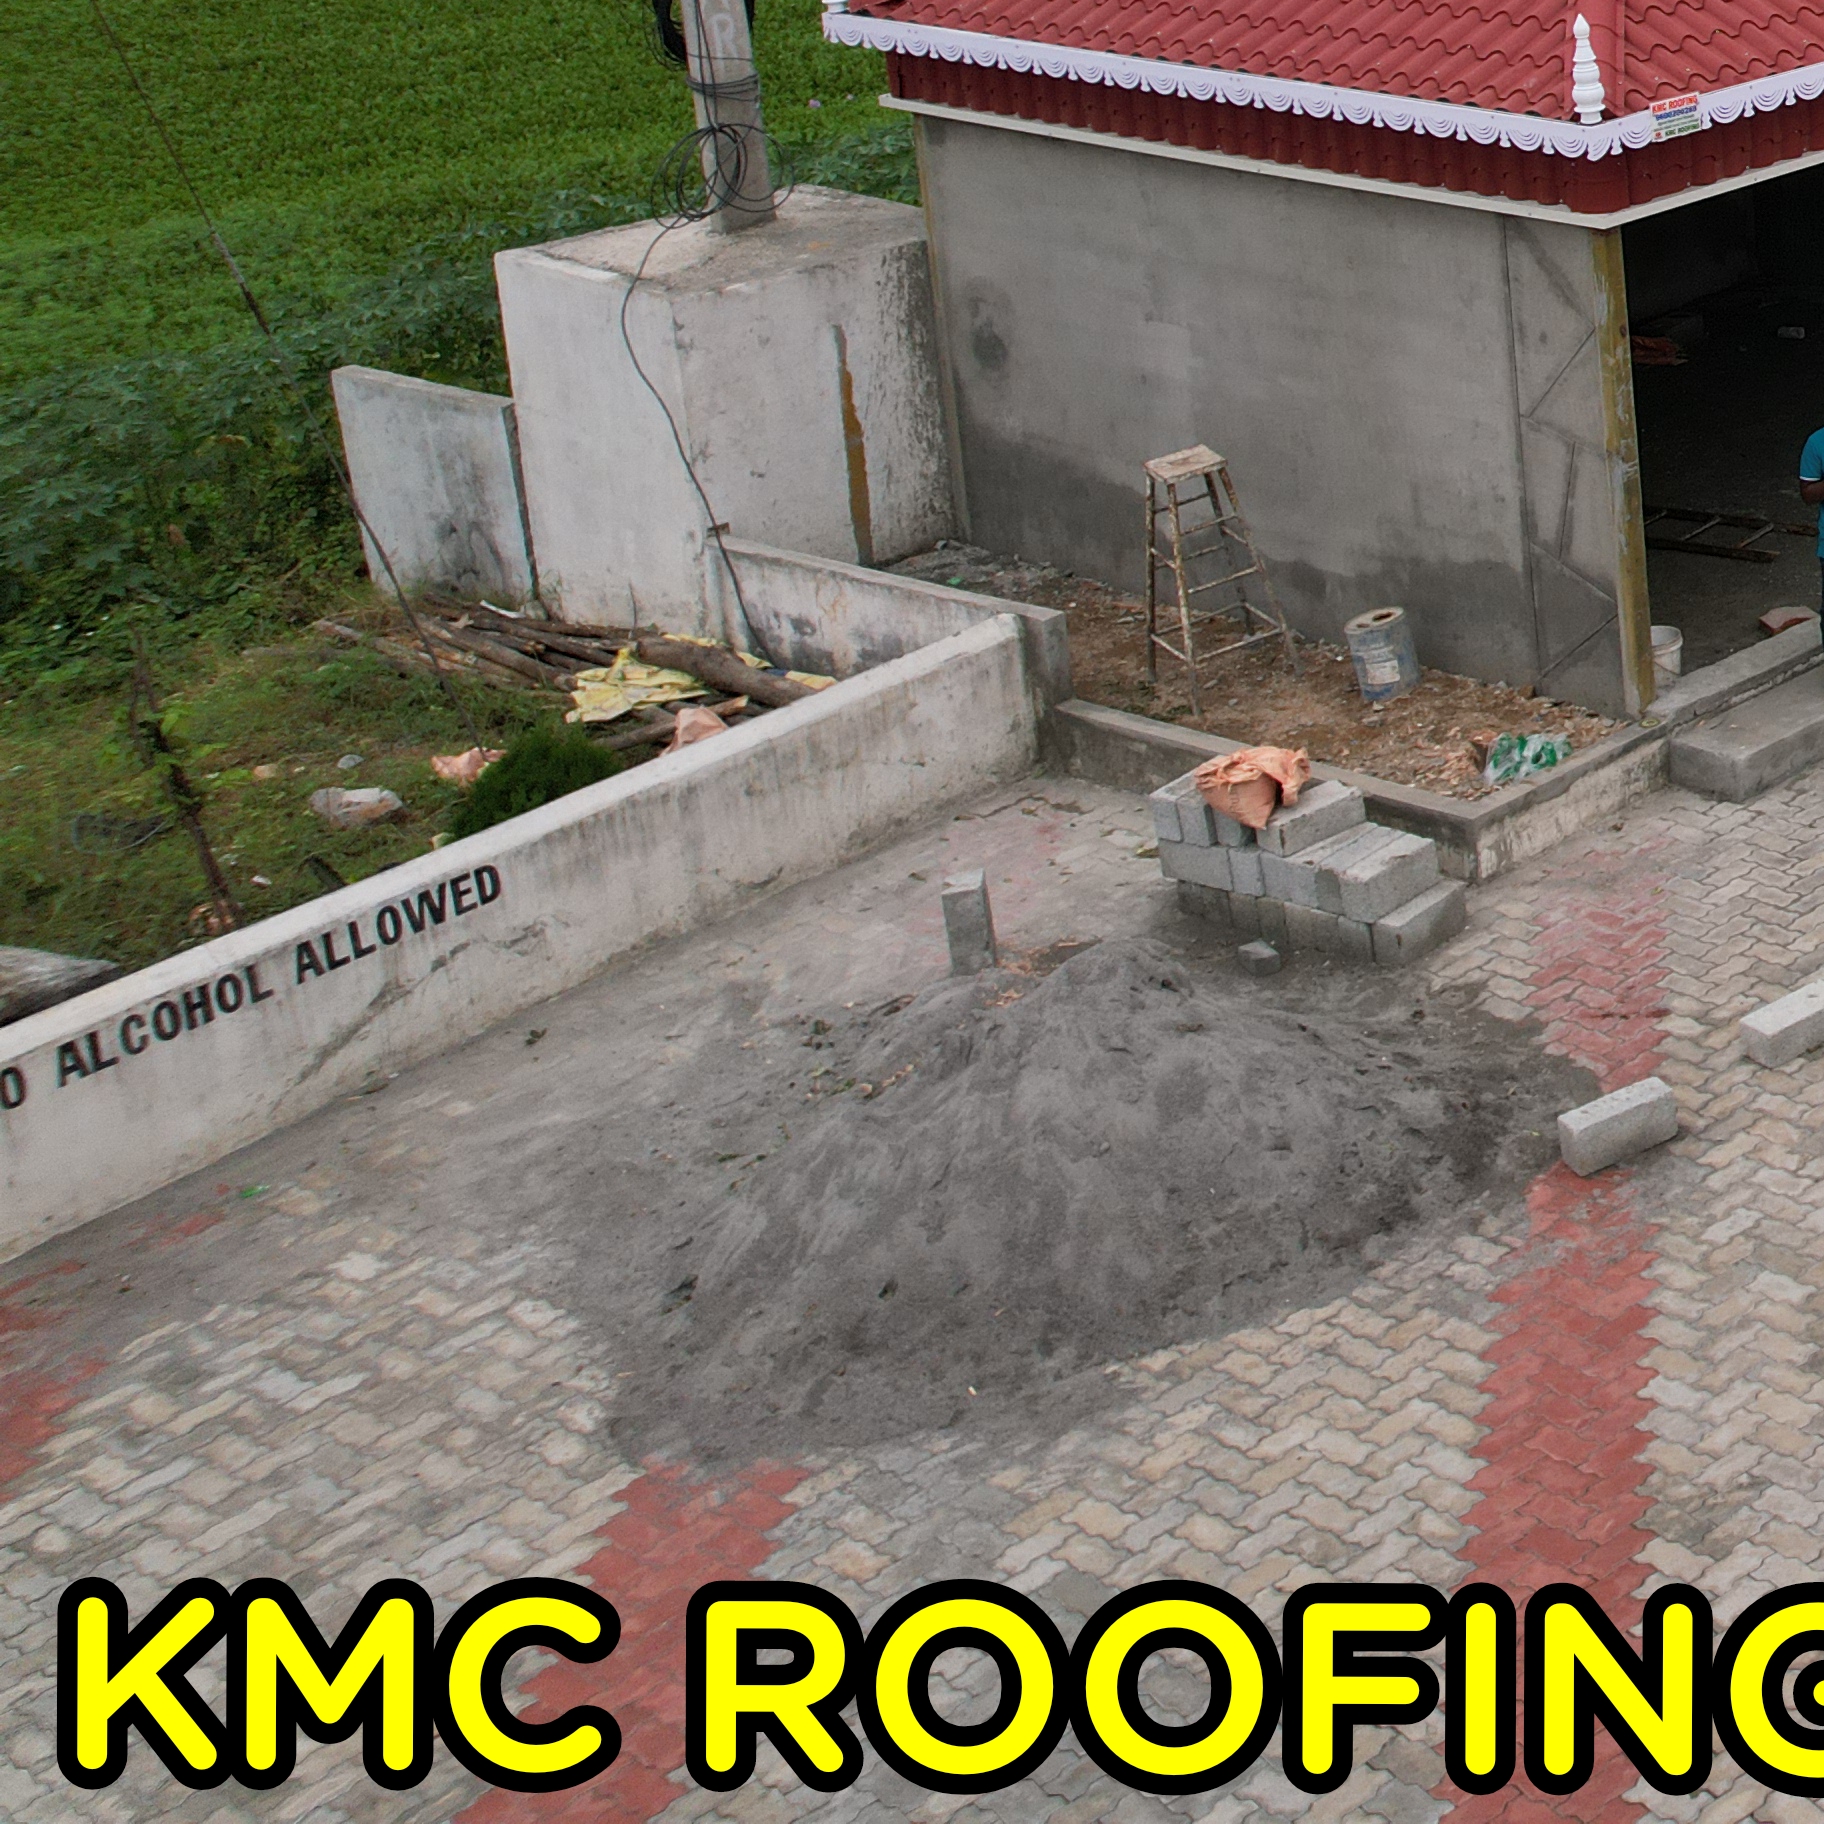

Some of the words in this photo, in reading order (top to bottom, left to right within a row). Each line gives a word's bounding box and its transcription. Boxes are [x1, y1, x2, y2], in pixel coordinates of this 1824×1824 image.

[0, 1066, 27, 1110] O
[56, 964, 274, 1088] ALCOHOL
[296, 863, 502, 985] ALLOWED
